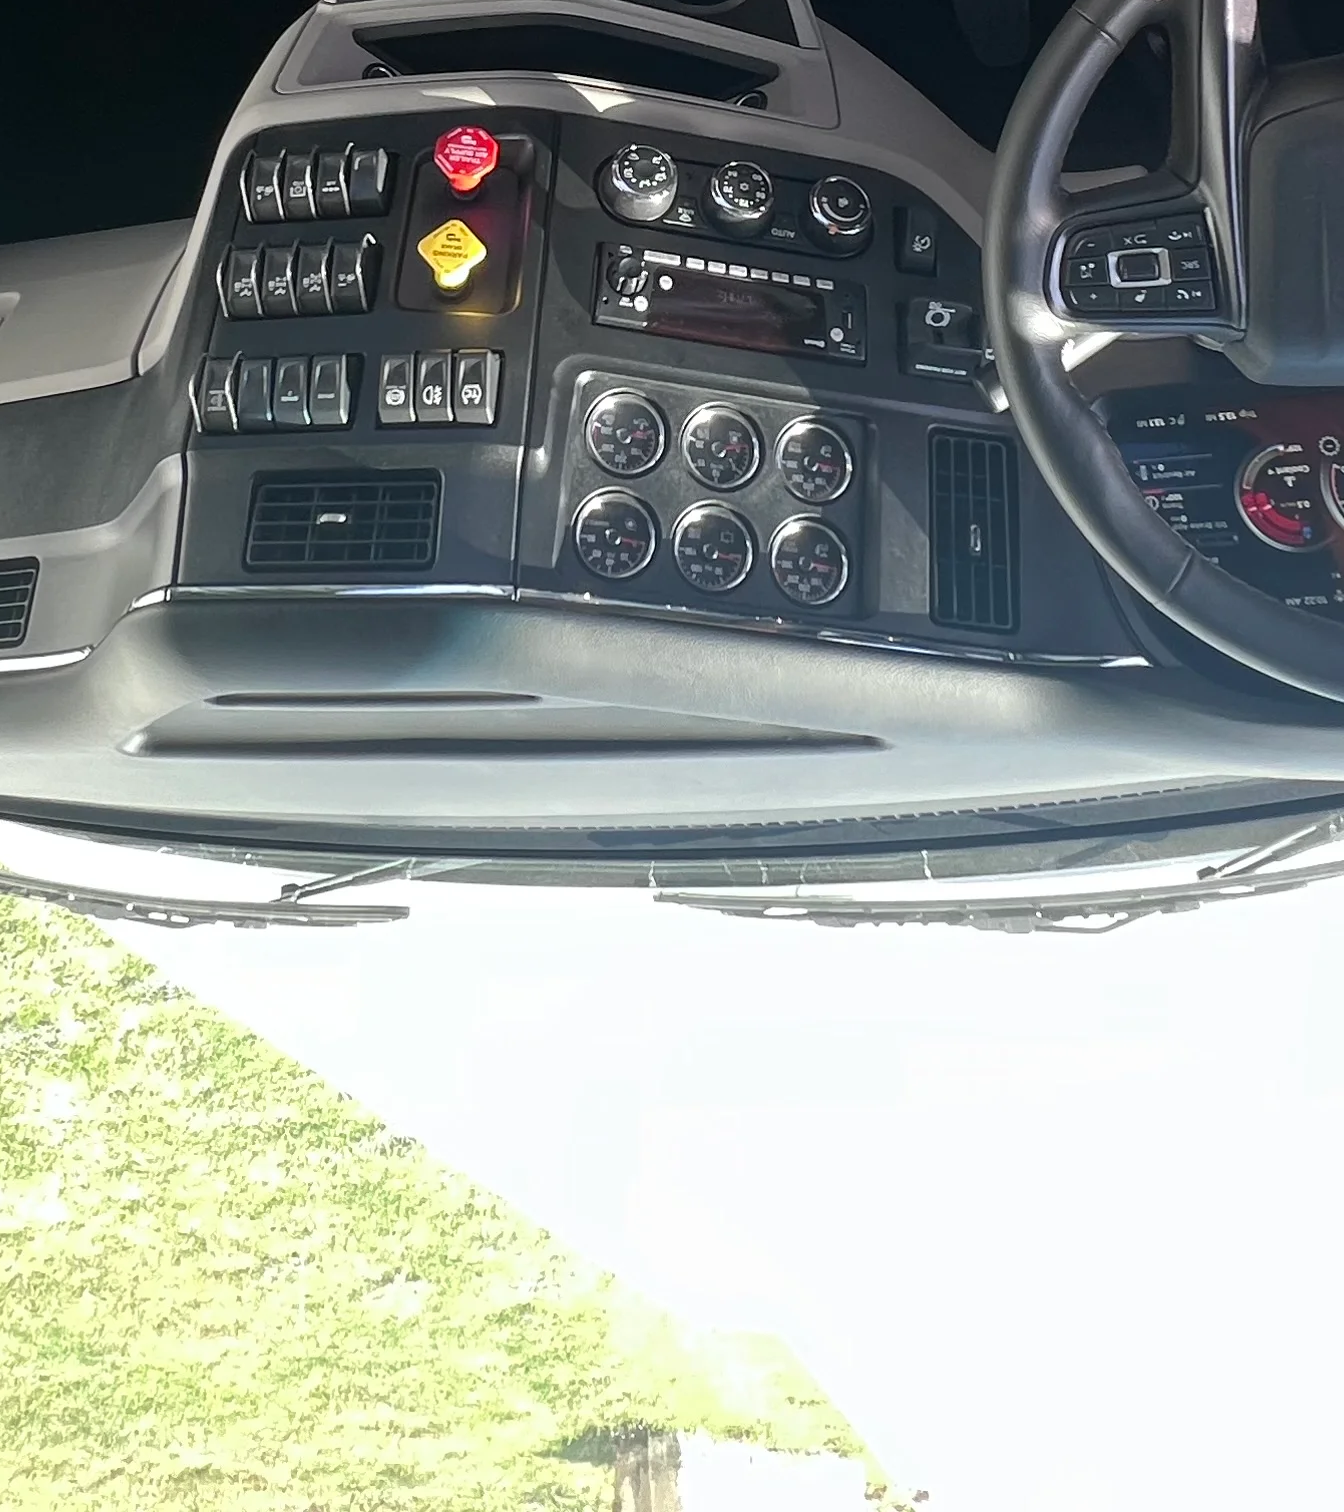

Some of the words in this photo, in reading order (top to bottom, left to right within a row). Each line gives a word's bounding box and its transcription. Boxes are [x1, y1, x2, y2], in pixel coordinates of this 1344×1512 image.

[444, 147, 474, 157] SUPPLY
[449, 155, 481, 165] TRAILER
[771, 228, 796, 239] AUTO
[432, 249, 468, 260] PARKING
[1180, 259, 1200, 270] SRC
[1217, 412, 1236, 421] 13.5
[1275, 464, 1310, 475] Coolant
[1285, 596, 1301, 606] AM
